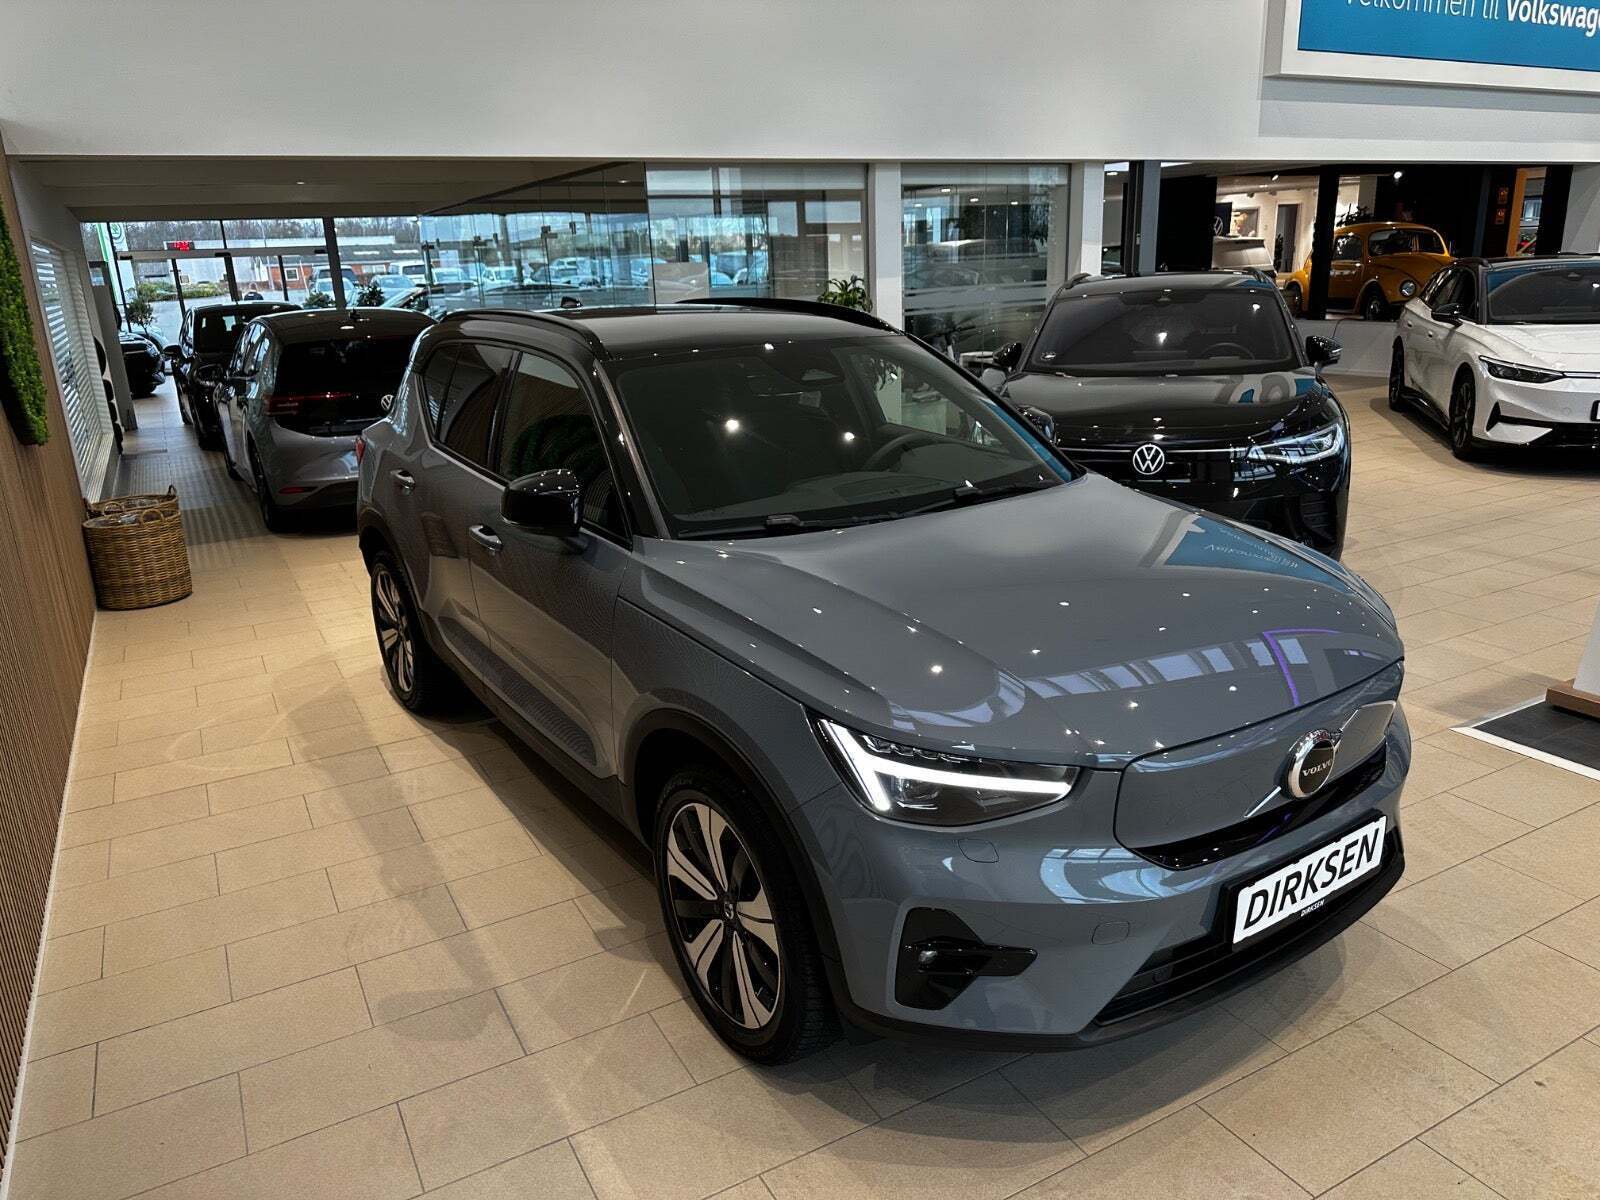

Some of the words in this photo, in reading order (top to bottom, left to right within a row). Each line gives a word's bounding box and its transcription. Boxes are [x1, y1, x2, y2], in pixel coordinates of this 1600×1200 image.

[1346, 0, 1475, 17] ommen
[1482, 0, 1499, 19] til
[1507, 0, 1600, 37] Volkswag
[1302, 759, 1332, 777] VOLVO
[1243, 827, 1380, 930] DIRKSEN
[1300, 899, 1325, 917] DIRKSEN
